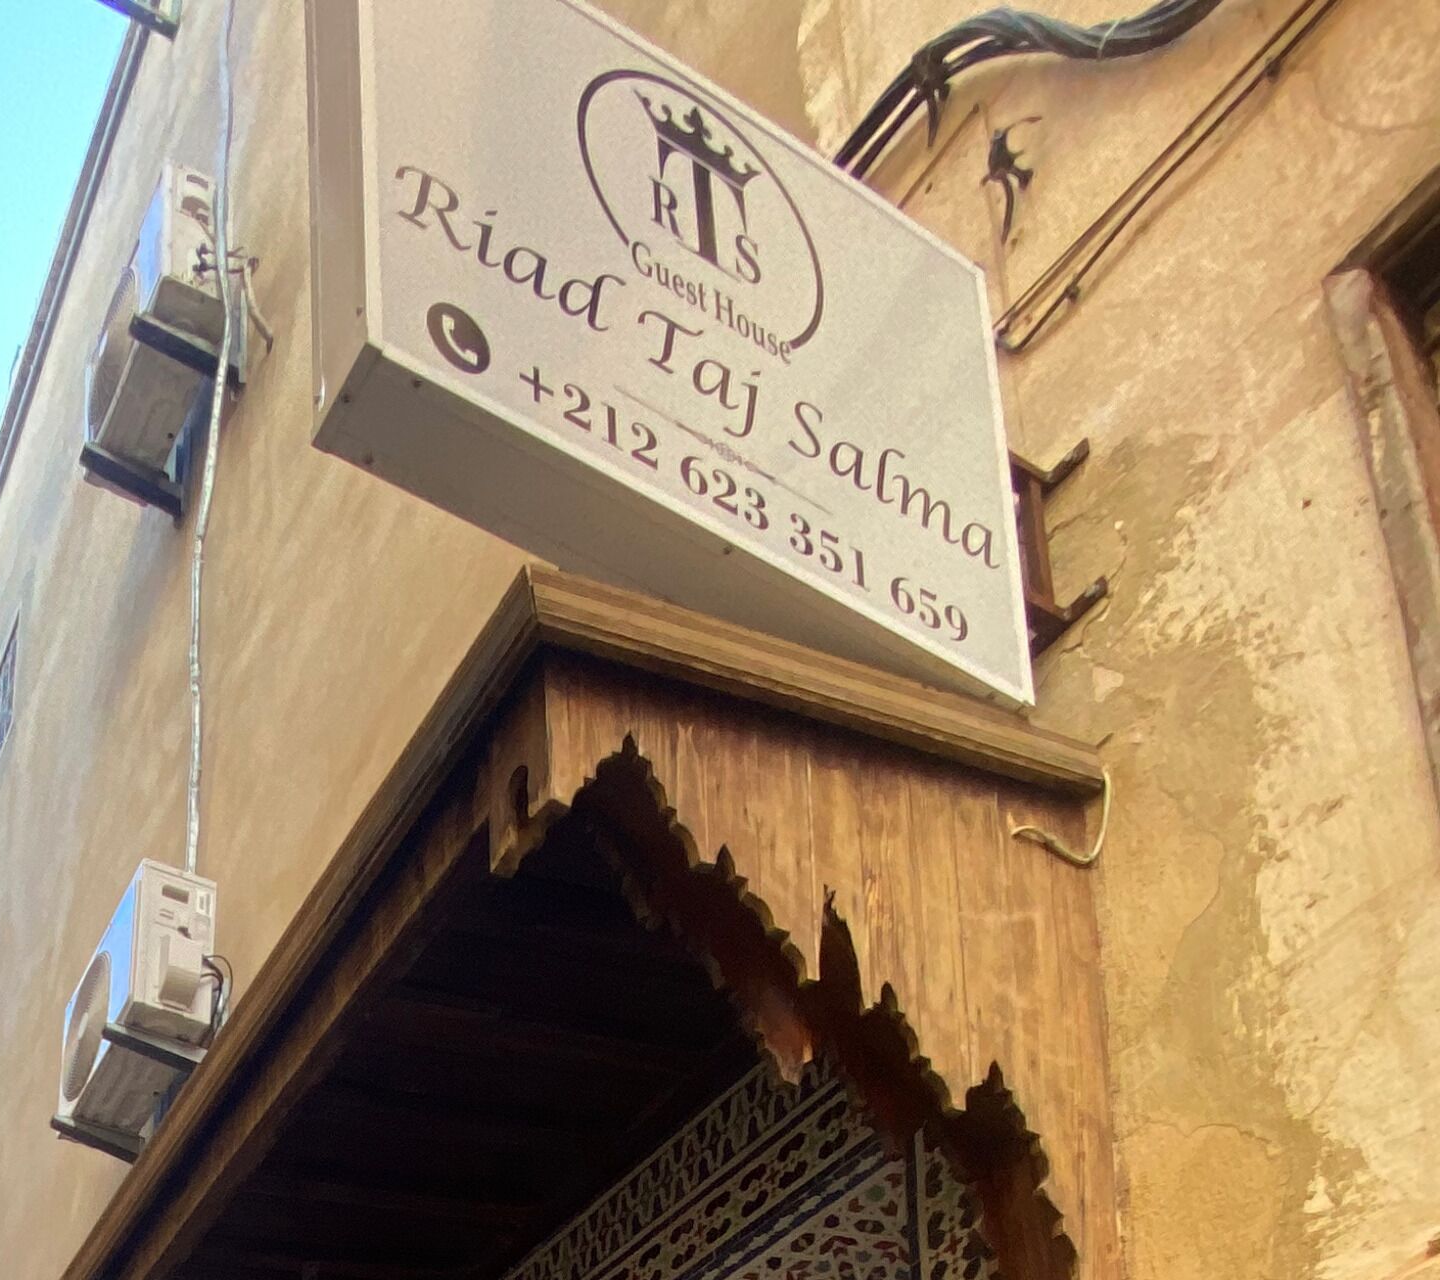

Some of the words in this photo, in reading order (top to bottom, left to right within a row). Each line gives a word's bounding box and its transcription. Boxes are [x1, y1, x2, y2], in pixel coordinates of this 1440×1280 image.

[394, 165, 626, 331] Riad
[637, 310, 762, 438] Taj
[788, 401, 1001, 570] Salma
[631, 240, 707, 313] Guest
[714, 288, 791, 365] House
[519, 366, 660, 470] +212
[679, 455, 770, 532] 623
[789, 511, 870, 592] 351
[890, 576, 969, 642] 659
